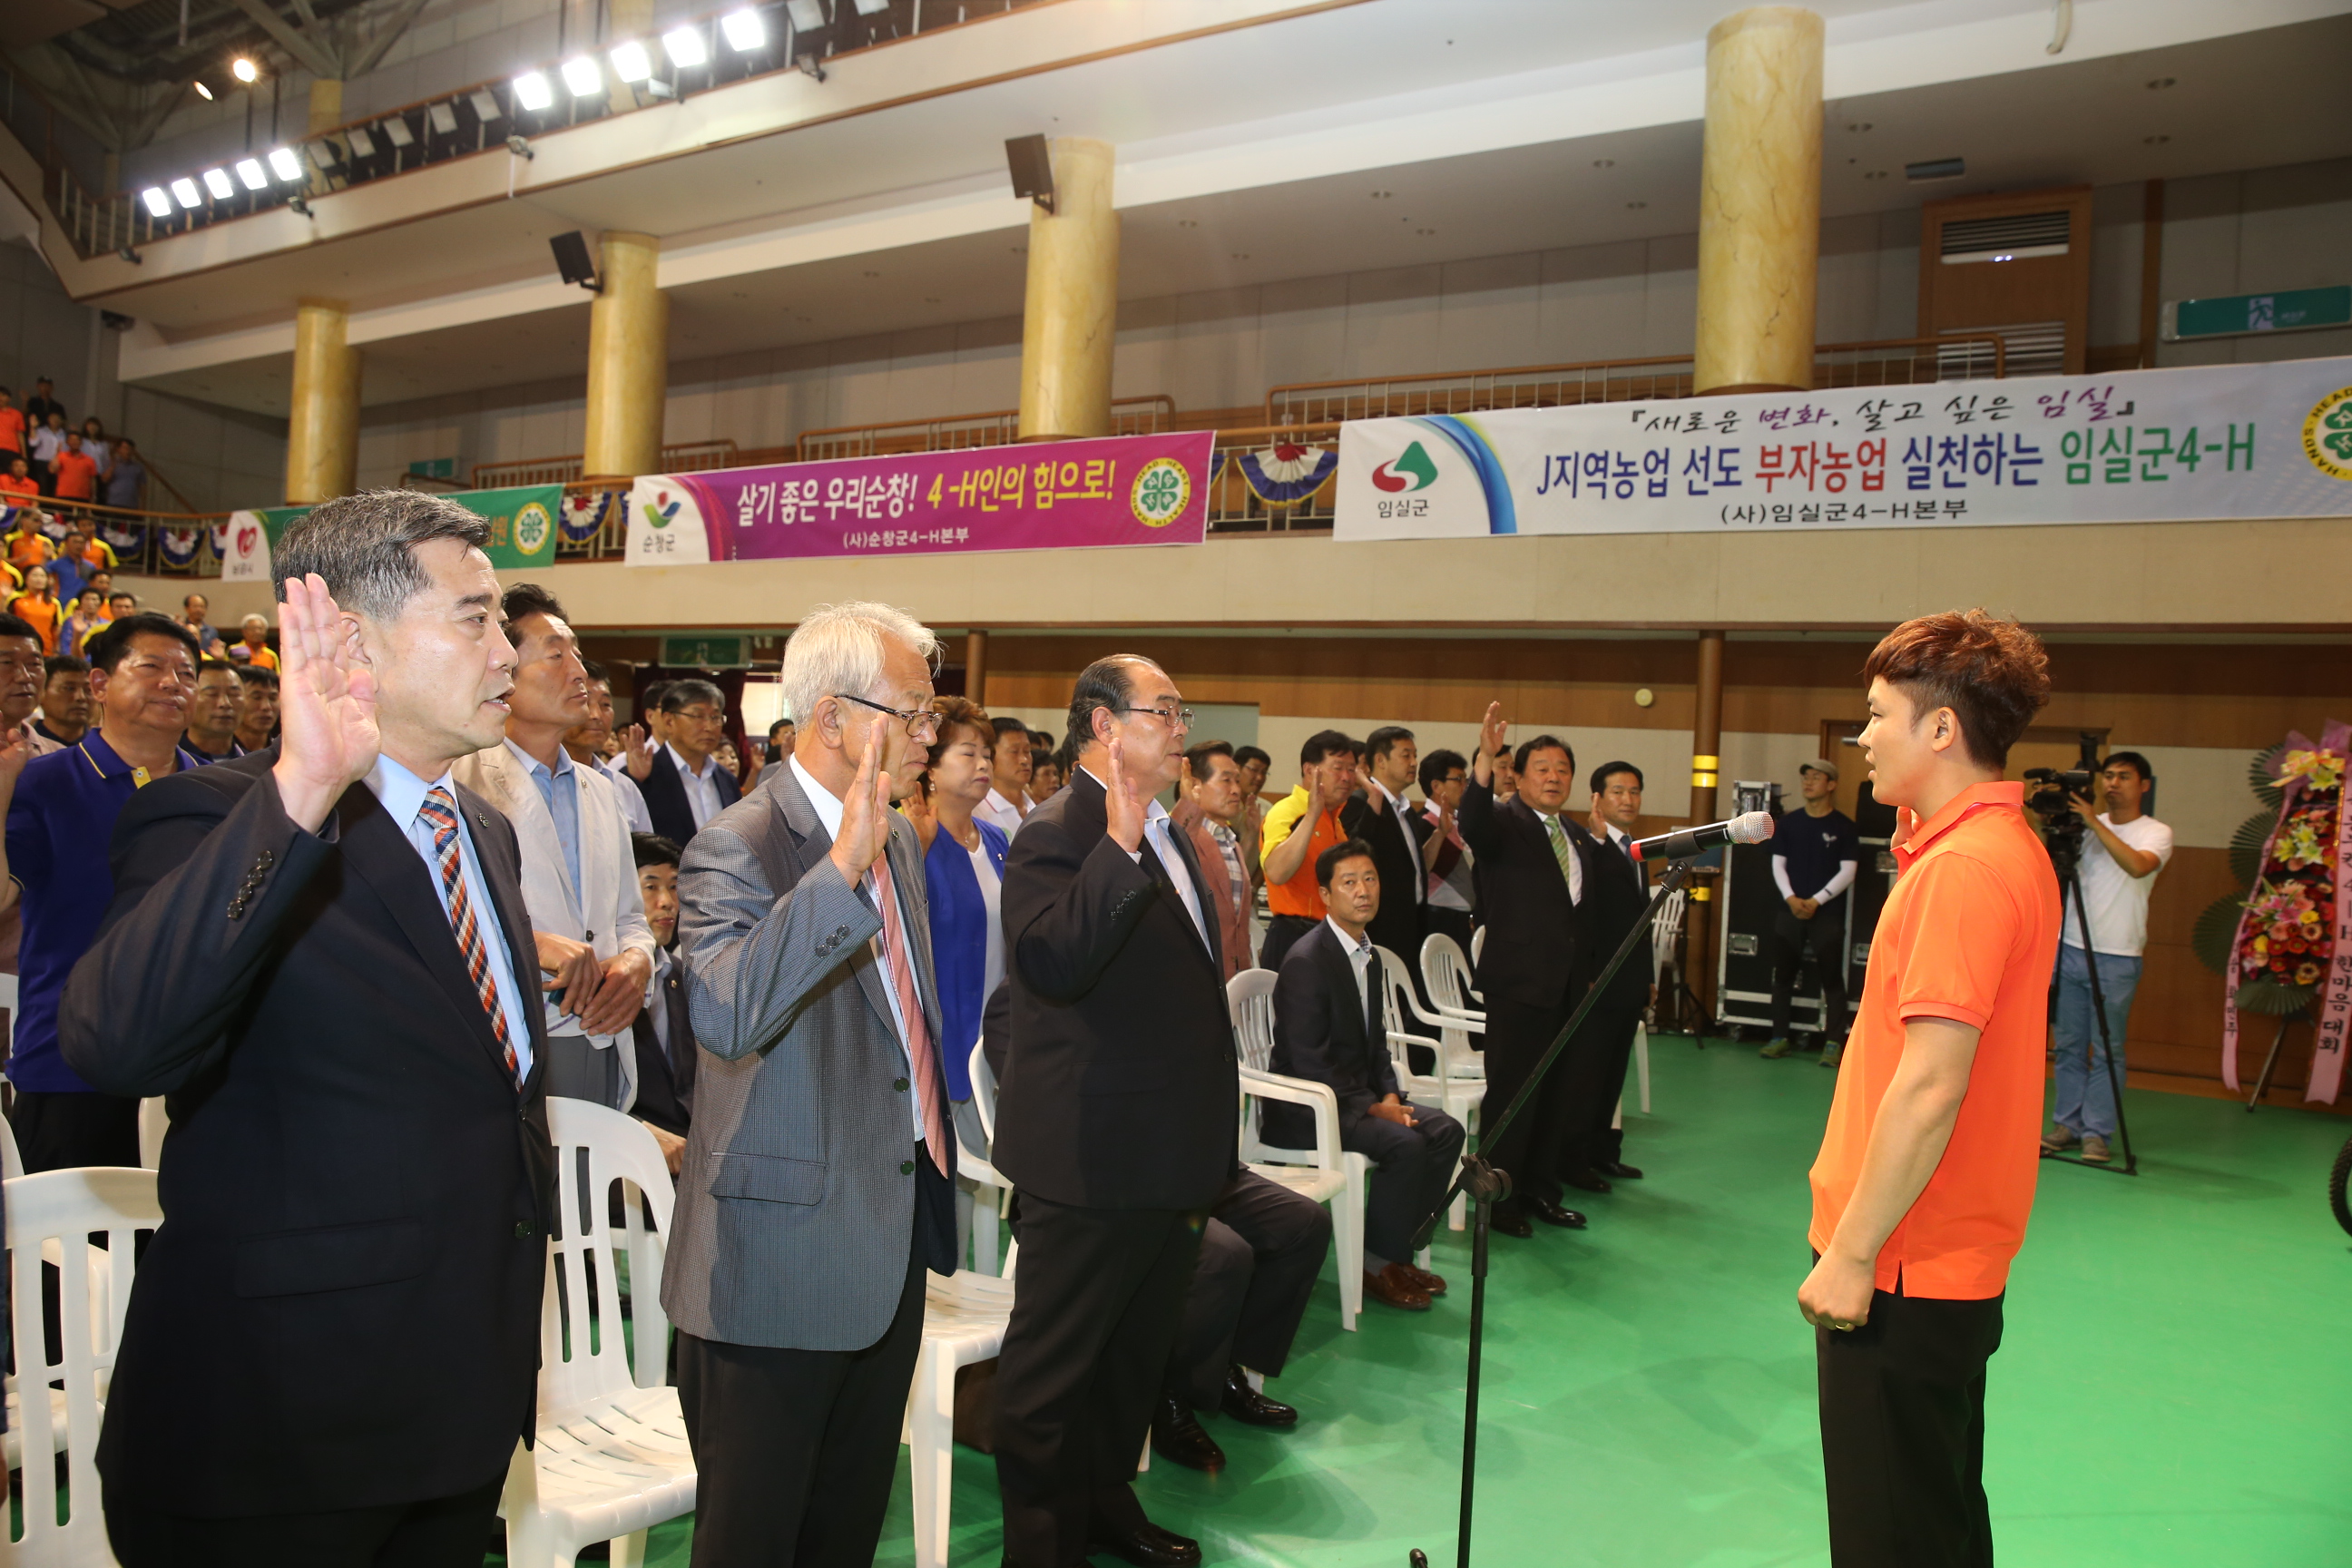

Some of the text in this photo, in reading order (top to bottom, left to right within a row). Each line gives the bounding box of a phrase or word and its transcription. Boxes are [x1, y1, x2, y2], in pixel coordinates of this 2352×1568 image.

[1857, 399, 1924, 432] 살고
[1945, 396, 2014, 424] 싶은
[1537, 423, 2255, 499] J지역농업 선도 부자농업 실천하는 임실군4-H
[738, 482, 776, 526] 살기
[779, 479, 819, 524] 좋은
[824, 473, 918, 520] 우리순창!
[1034, 460, 1116, 509] 힘으로!
[1377, 500, 1430, 518] 임실군
[1720, 500, 1968, 524] (사)임실군4-H본부
[643, 534, 675, 554] 순창군
[843, 526, 969, 549] (사)순창군4-H본부
[2318, 1017, 2345, 1054] 대회
